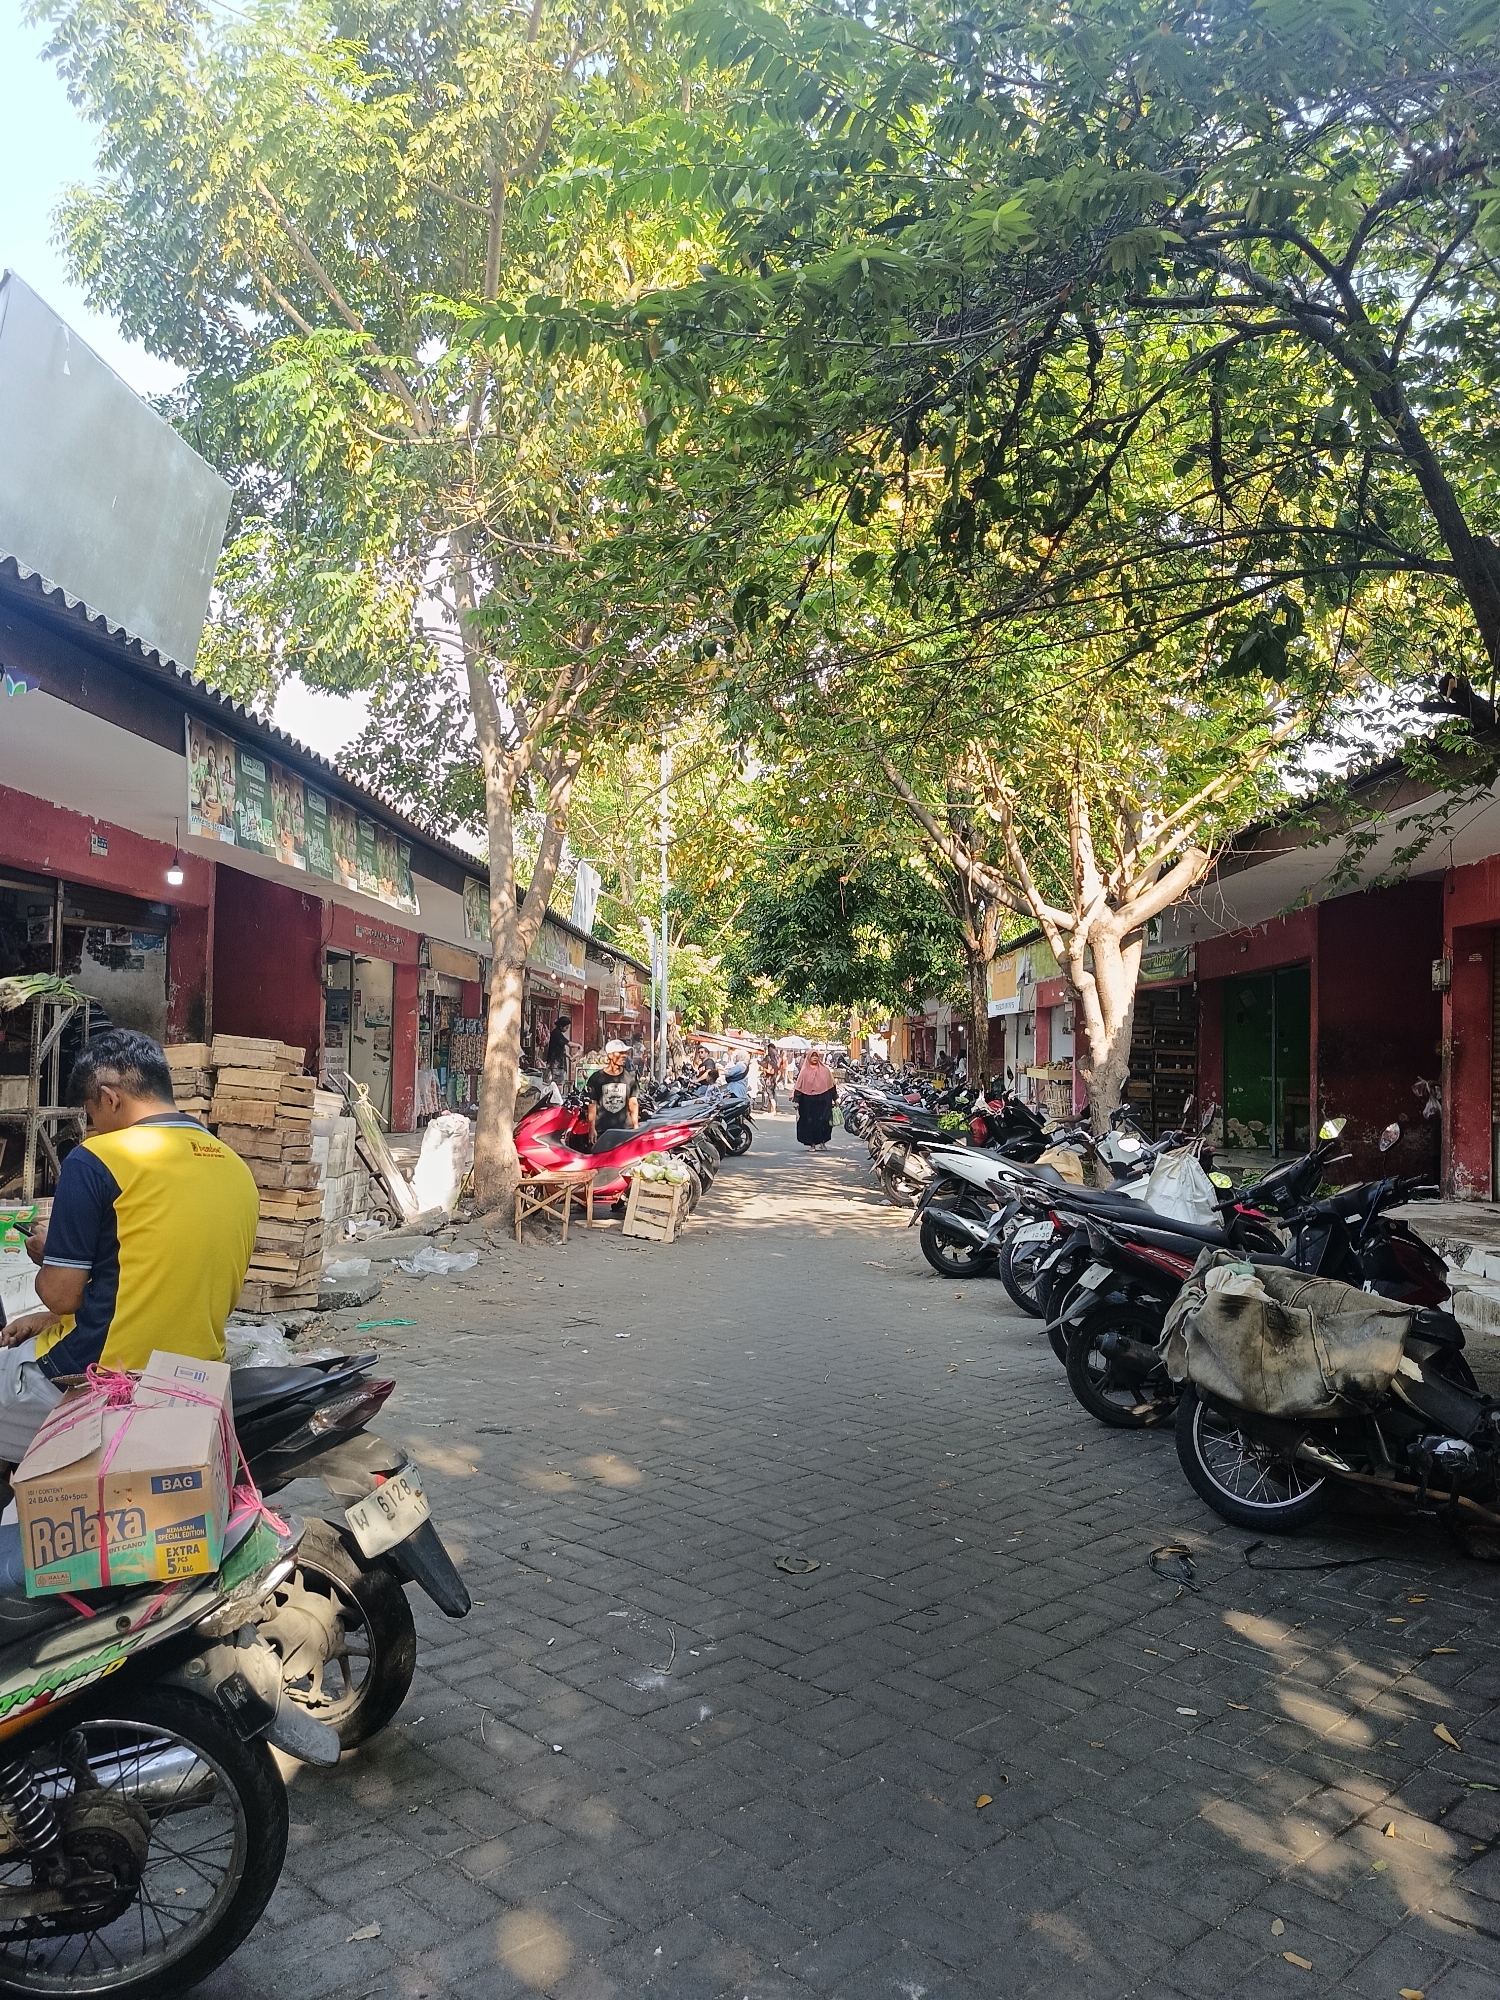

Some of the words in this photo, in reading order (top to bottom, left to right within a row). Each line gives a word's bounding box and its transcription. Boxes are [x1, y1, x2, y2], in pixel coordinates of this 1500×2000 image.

[162, 1477, 193, 1490] BAG
[38, 1487, 65, 1495] CONTENT:
[38, 1495, 53, 1503] BAG
[352, 1508, 370, 1531] W
[376, 1478, 412, 1513] 6128
[158, 1531, 182, 1542] SPECIAL
[182, 1529, 205, 1539] EDITION
[166, 1524, 195, 1534] KEMASAN
[31, 1507, 146, 1569] Relaxa
[122, 1540, 147, 1551] CANDY
[166, 1544, 200, 1557] EXTRA
[167, 1557, 177, 1574] 5
[182, 1565, 194, 1573] BAG
